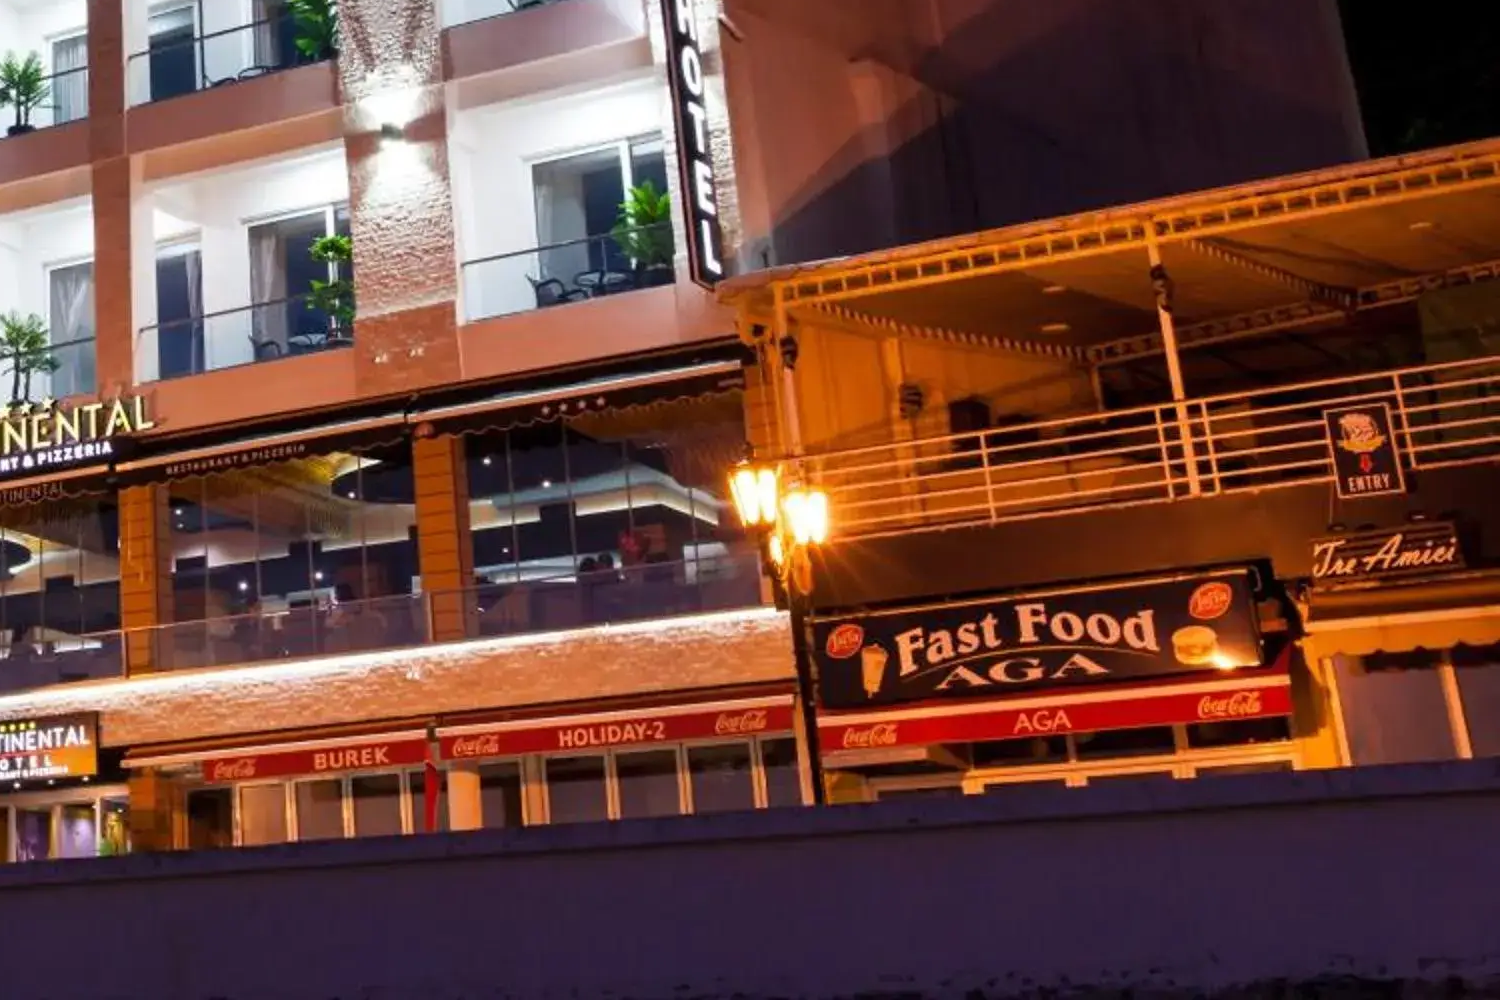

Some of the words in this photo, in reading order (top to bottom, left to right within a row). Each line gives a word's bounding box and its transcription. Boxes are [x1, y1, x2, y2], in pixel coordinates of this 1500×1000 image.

[22, 456, 34, 468] &
[38, 441, 112, 464] PIZZERIA
[1348, 473, 1390, 492] ENTRY
[1312, 538, 1356, 577] Tre
[1361, 533, 1457, 571] Amici
[895, 612, 1001, 677] Fast
[1015, 603, 1160, 652] Food
[933, 653, 1111, 690] AGA
[558, 721, 665, 748] HOLIDAY-2
[1013, 709, 1072, 734] AGA
[314, 746, 389, 770] BUREK
